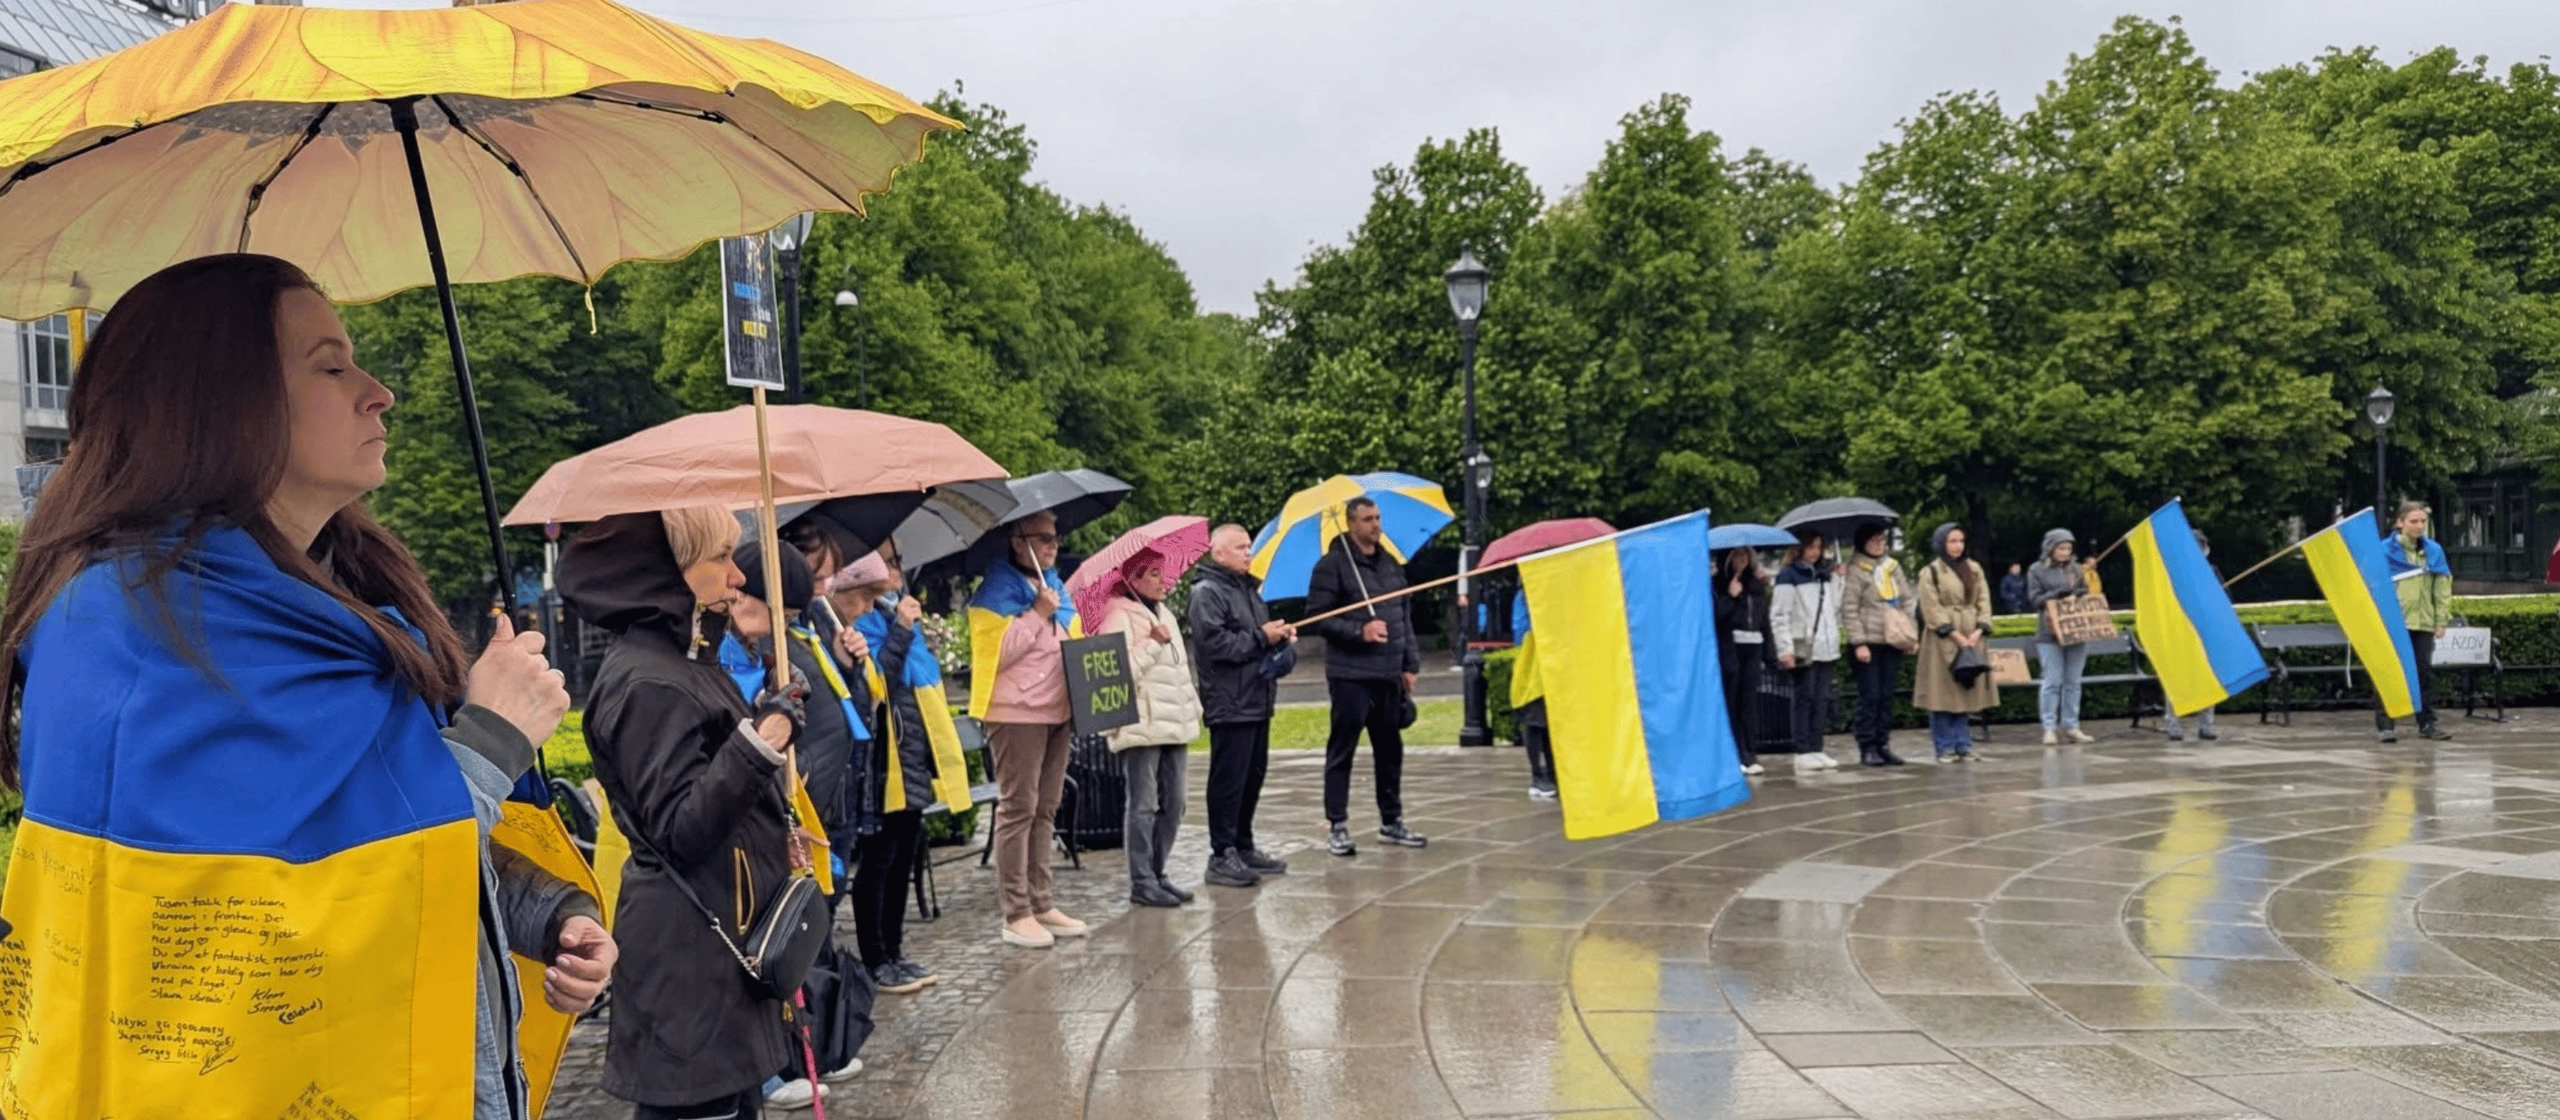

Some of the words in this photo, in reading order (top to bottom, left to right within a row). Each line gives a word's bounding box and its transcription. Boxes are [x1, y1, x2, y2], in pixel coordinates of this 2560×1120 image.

[2452, 635, 2485, 650] AZOV
[1083, 649, 1120, 681] FREE
[1091, 684, 1129, 715] AZOV
[152, 896, 187, 908] Tusen
[227, 896, 244, 909] for
[264, 913, 284, 923] Det
[152, 922, 169, 932] har
[152, 947, 168, 958] Du
[195, 949, 209, 959] et
[213, 950, 269, 964] fantastisk
[201, 965, 212, 973] er
[250, 968, 271, 978] som
